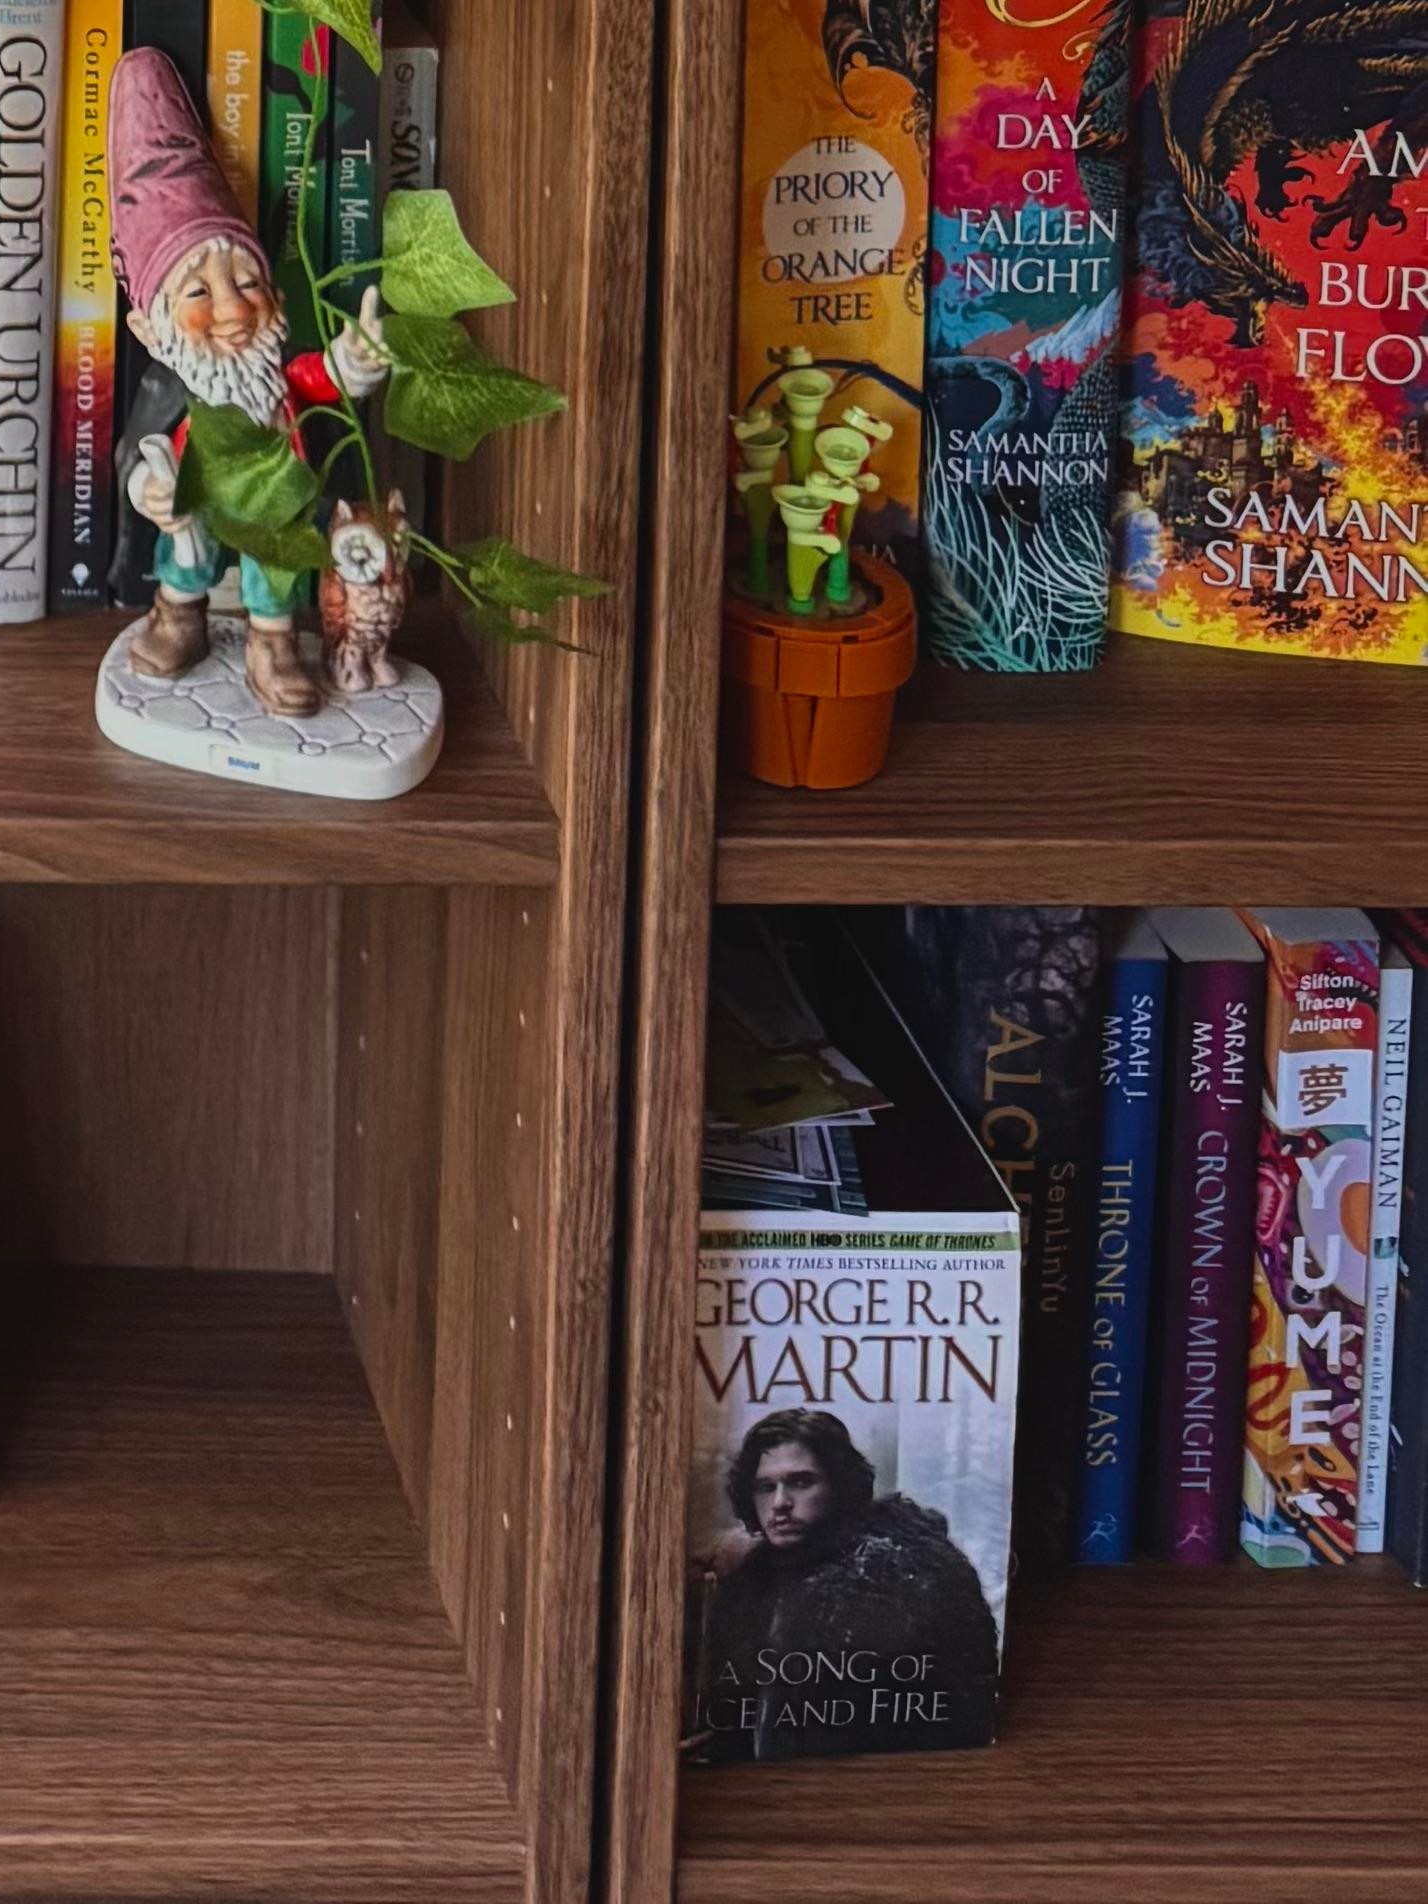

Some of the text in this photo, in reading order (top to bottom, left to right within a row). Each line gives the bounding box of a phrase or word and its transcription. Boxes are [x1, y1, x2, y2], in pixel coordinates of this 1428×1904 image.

[997, 114, 1093, 149] DAY
[774, 172, 894, 205] PRIORY
[959, 210, 1118, 245] FALLEN
[762, 246, 906, 283] ORANGE
[963, 257, 1113, 293] NIGHT
[790, 292, 875, 325] TREE
[1299, 972, 1354, 991] Sifton
[1296, 994, 1357, 1013] Tracey
[1289, 1012, 1362, 1034] Anipare
[1298, 1065, 1347, 1116] 夢
[839, 1258, 1005, 1270] BESTSELLING AUTHOR
[1178, 1127, 1229, 1495] CROWN OF MIDNIGHT
[1286, 1156, 1346, 1446] YUME
